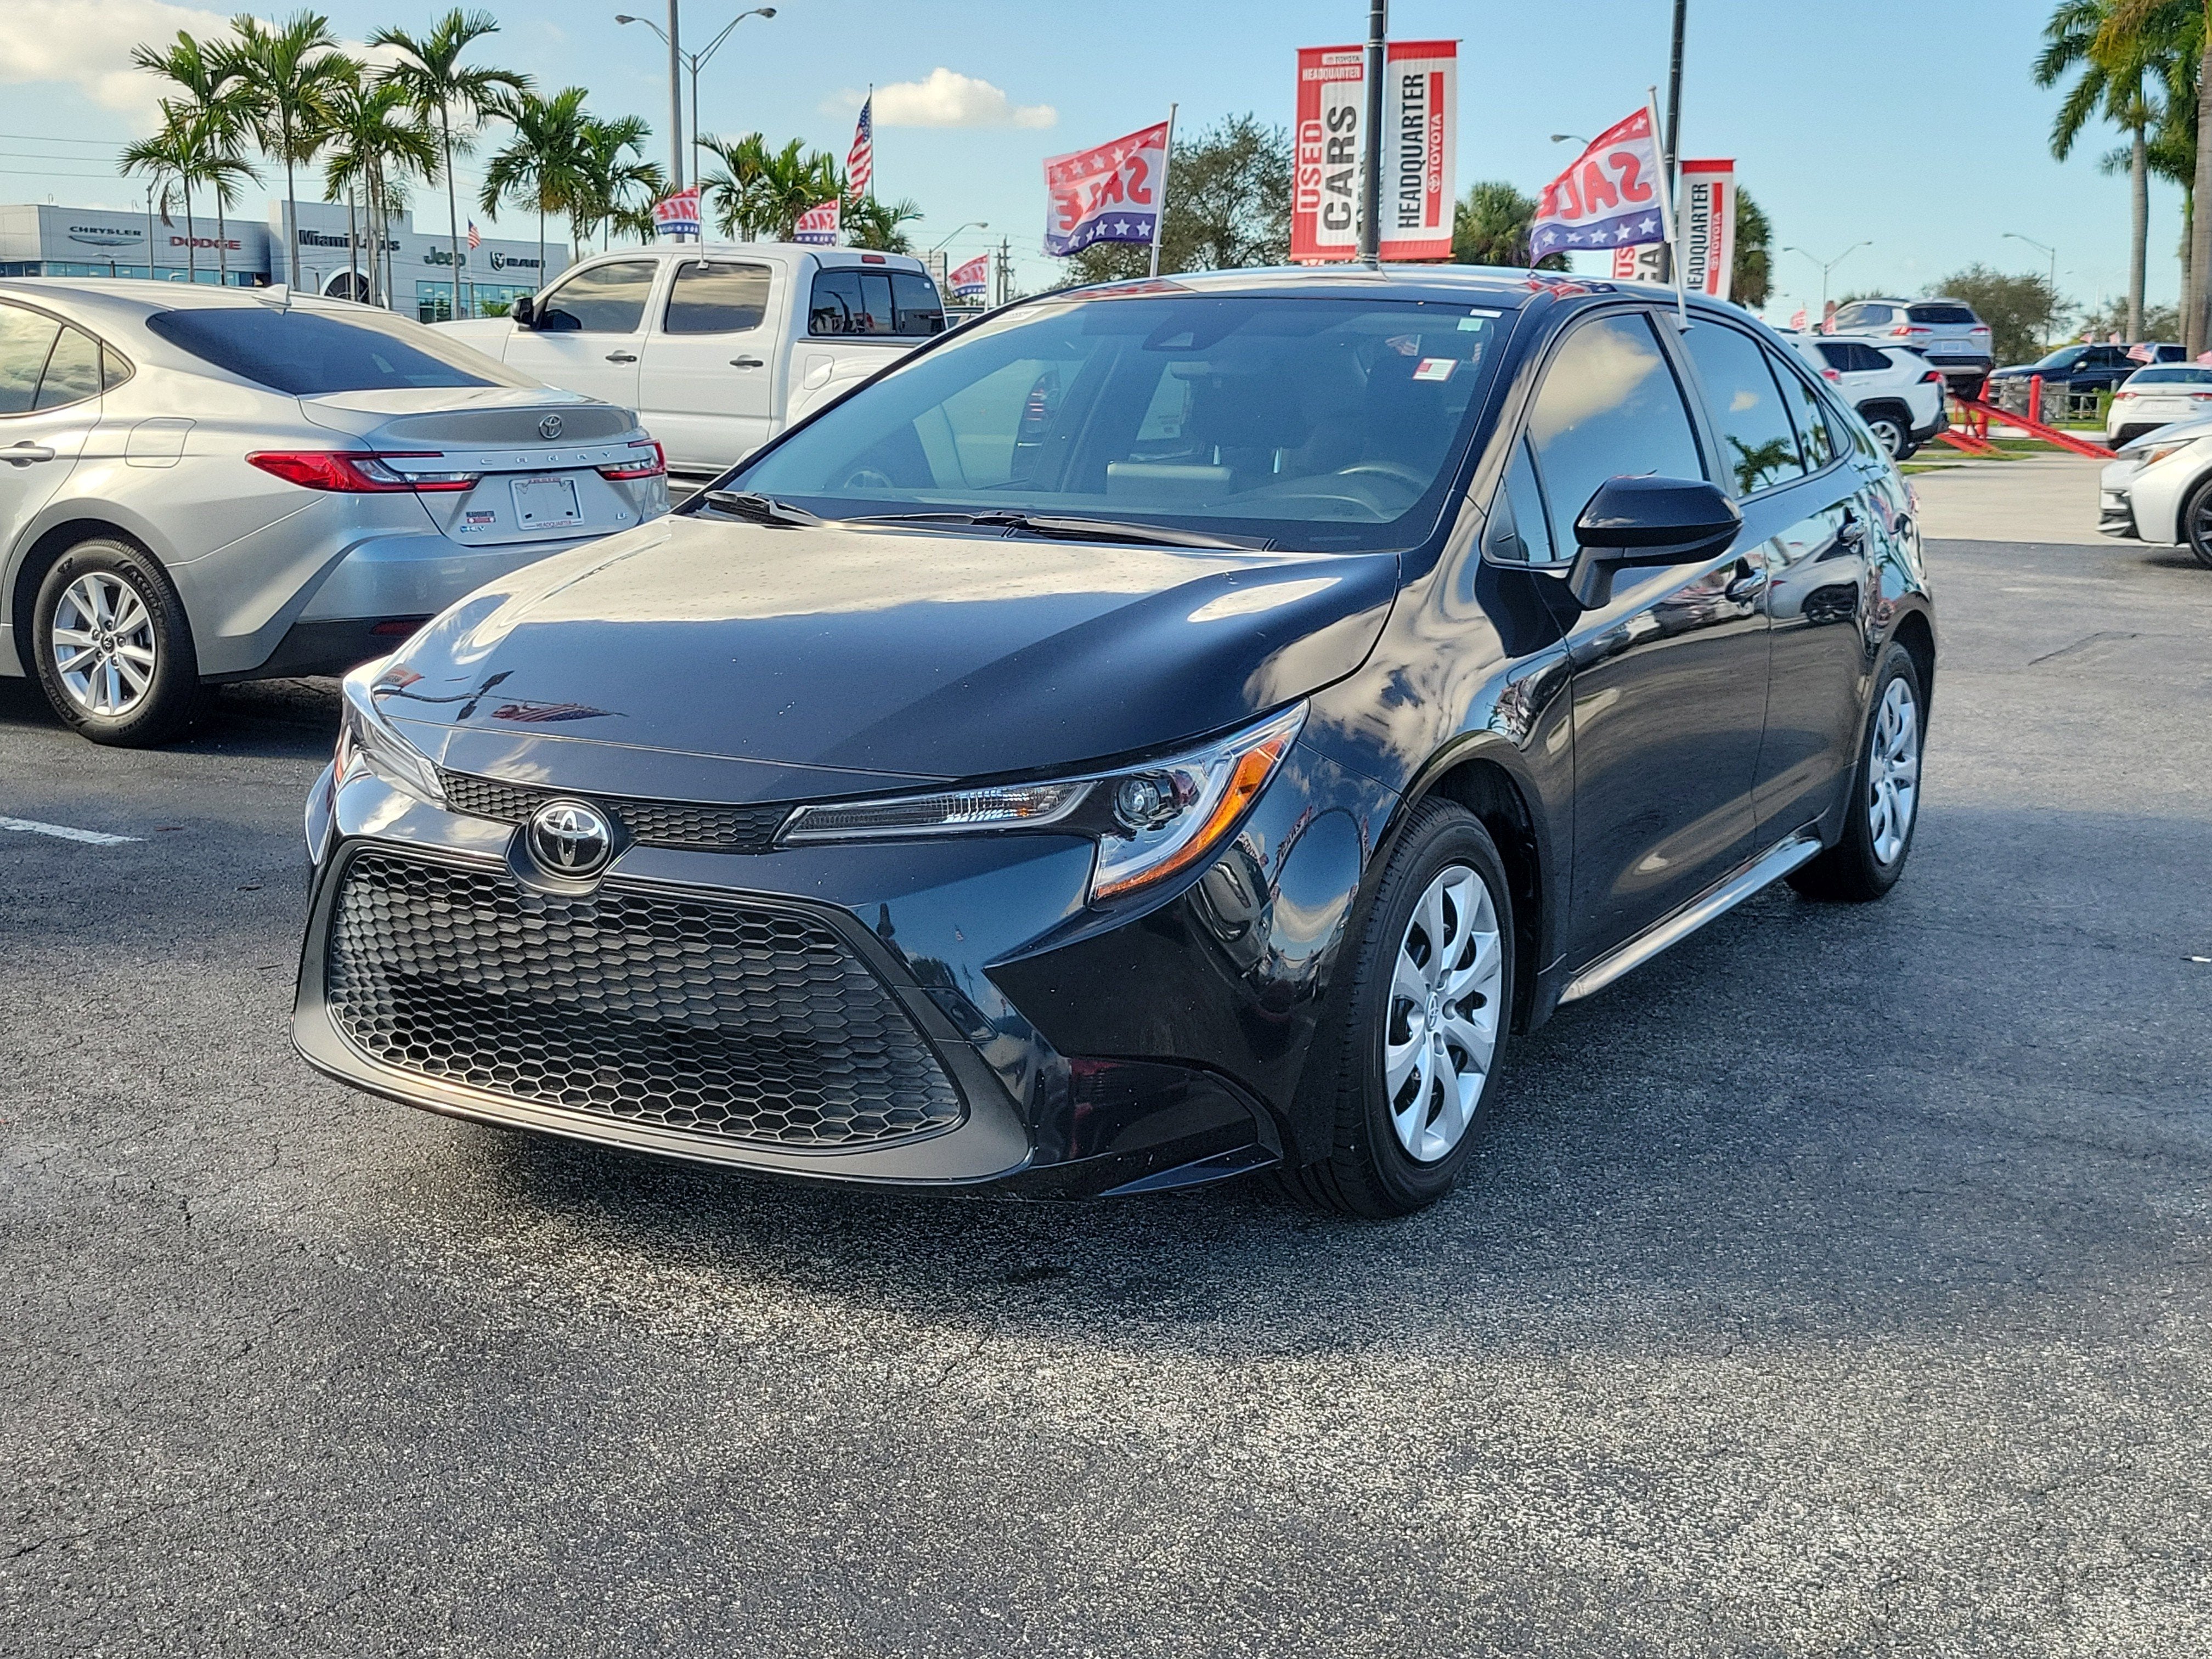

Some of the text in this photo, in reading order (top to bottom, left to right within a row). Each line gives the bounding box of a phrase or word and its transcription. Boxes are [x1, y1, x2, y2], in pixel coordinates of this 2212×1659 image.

[1302, 66, 1361, 82] HEADQUARTER
[1397, 73, 1424, 229] HEADQUARTER
[1429, 114, 1443, 173] TOYOTA
[1300, 121, 1322, 211] USED
[1324, 105, 1357, 231] CARS
[69, 225, 142, 236] CHRYSLER
[298, 229, 351, 248] Miami
[170, 236, 242, 250] DODGE
[424, 246, 466, 267] Jeep
[481, 452, 612, 465] CAMRY
